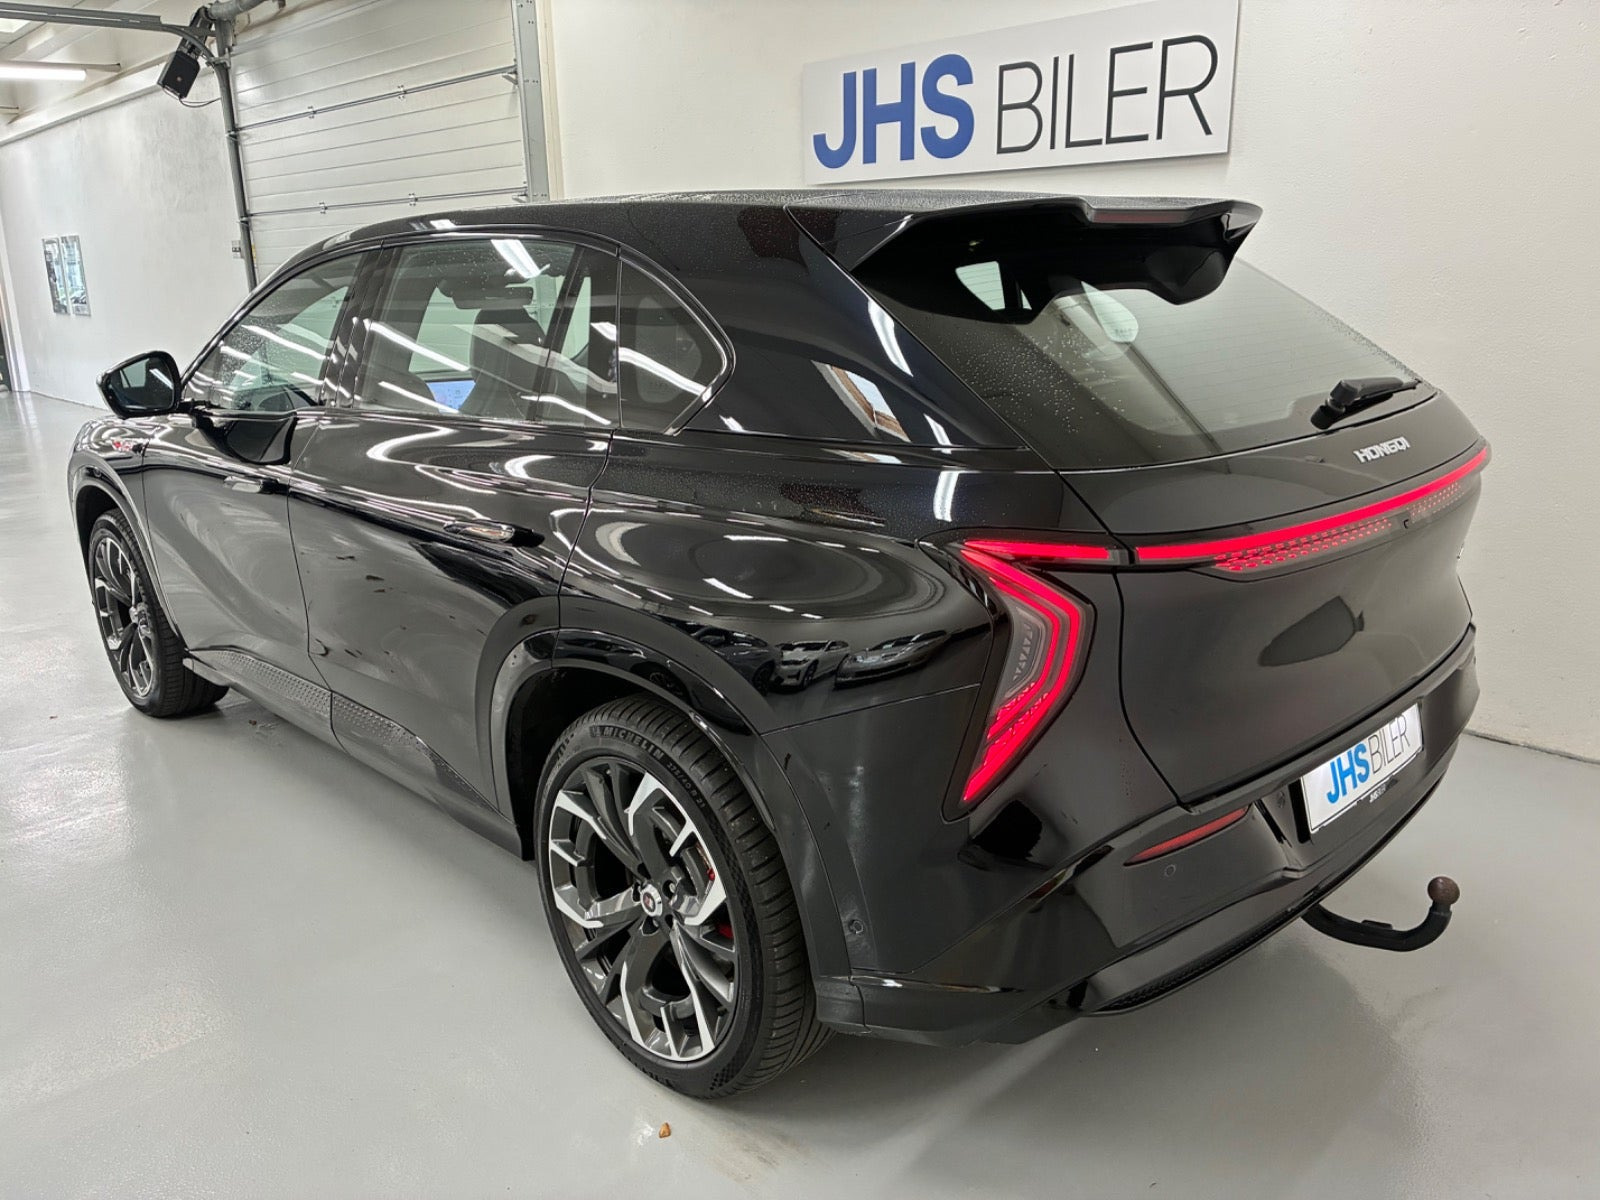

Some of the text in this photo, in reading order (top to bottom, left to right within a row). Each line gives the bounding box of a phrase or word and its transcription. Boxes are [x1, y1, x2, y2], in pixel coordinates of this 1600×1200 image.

[813, 34, 1219, 169] JHS BILER
[1353, 436, 1411, 463] HONGQI
[603, 726, 664, 759] MICHELIN
[1326, 714, 1411, 804] JHS BILER
